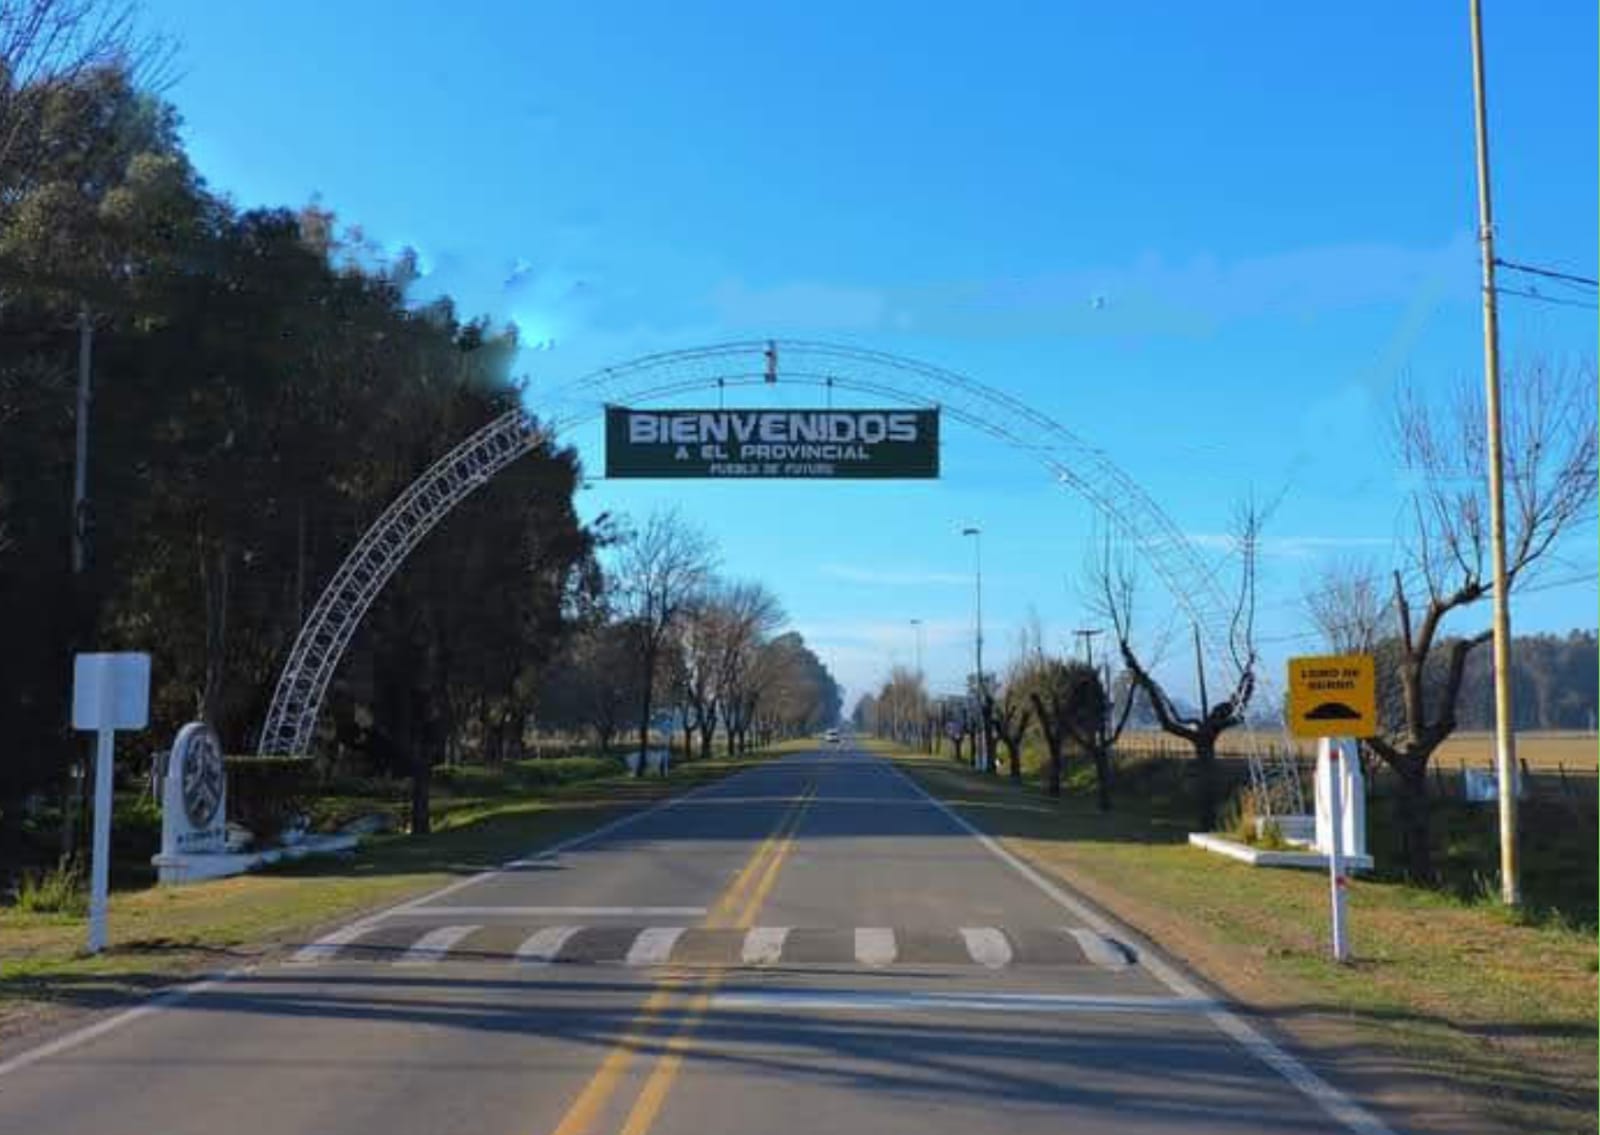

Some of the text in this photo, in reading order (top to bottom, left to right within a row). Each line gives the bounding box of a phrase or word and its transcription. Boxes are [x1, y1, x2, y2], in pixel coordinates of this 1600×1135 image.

[629, 413, 918, 443] BIENVENIDOS
[675, 445, 870, 460] A EL PROVINCIAL
[784, 463, 835, 475] FUTU
